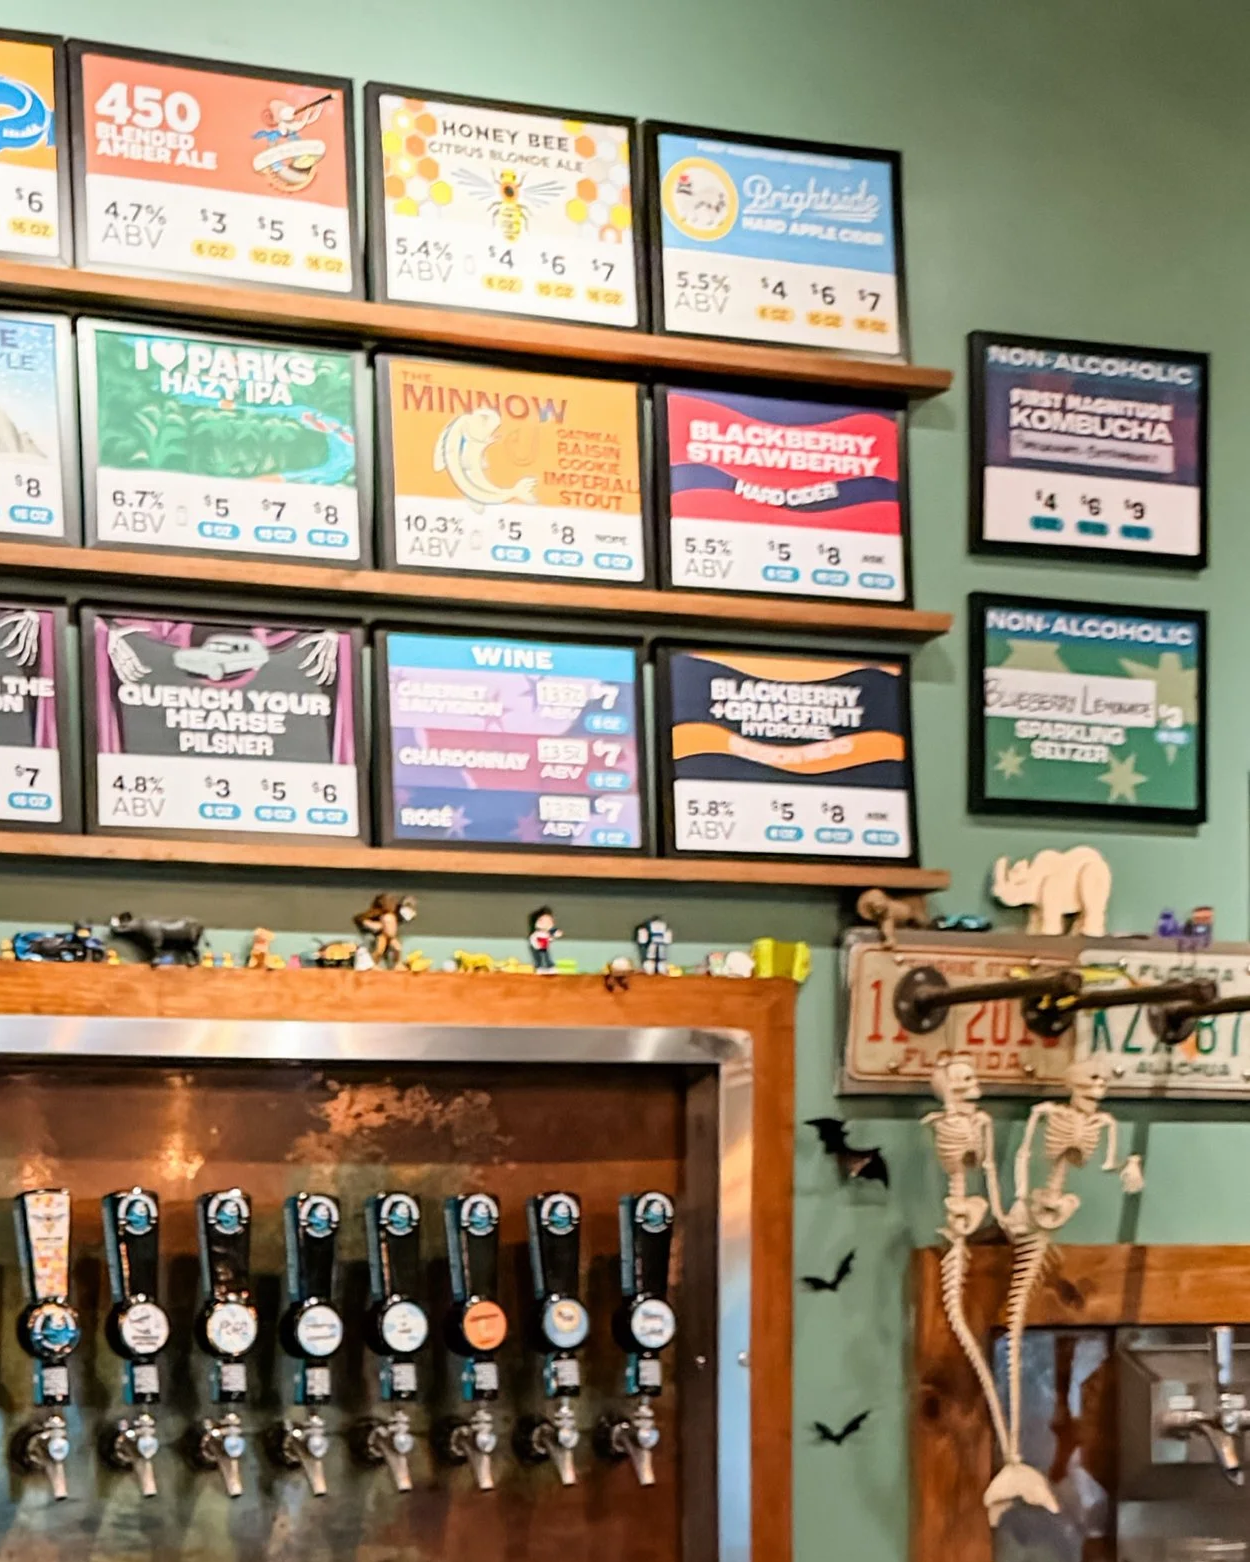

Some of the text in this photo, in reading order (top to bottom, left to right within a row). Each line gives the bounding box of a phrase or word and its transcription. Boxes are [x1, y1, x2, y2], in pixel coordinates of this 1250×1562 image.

[95, 81, 201, 134] 450
[442, 120, 570, 152] HONEY BEE
[96, 140, 218, 170] AMBER ALE
[428, 141, 584, 174] CITRUS BLONDE ALE
[105, 201, 167, 225] 4.7%
[743, 174, 881, 223] Brightside
[789, 222, 837, 241] APPLE
[396, 237, 453, 261] 5.4%
[677, 271, 881, 313] 5.5% $4 $6 $7
[135, 341, 317, 386] I PARKS
[401, 371, 433, 383] THE
[987, 344, 1194, 386] NON-ALCOHOLIC
[160, 370, 293, 406] HAZY IPA
[403, 383, 568, 424] MINNOW
[557, 429, 619, 445] OATMEAL
[689, 420, 877, 456] BLACKBERRY
[1010, 407, 1174, 444] KOMBUCHA
[557, 441, 620, 461] RAISIN
[686, 442, 881, 478] STRAWBERRY
[558, 459, 620, 475] COOKIE
[543, 471, 640, 495] IMPERIAL
[112, 490, 164, 510] 6.7%
[559, 491, 622, 511] STOUT
[406, 514, 575, 546] 10.3% $5 $8
[685, 537, 733, 556] 5.5%
[986, 608, 1194, 646] NON-ALCOHOLIC
[471, 643, 554, 671] WINE
[3, 676, 55, 698] THE
[117, 682, 332, 717] QUENCH YOUR
[709, 677, 864, 707] BLACKBERRY
[165, 707, 286, 735] HEARSE
[179, 730, 274, 757] PILSNER
[398, 745, 532, 771] CHARDONNAY
[112, 775, 165, 795] 4.8%
